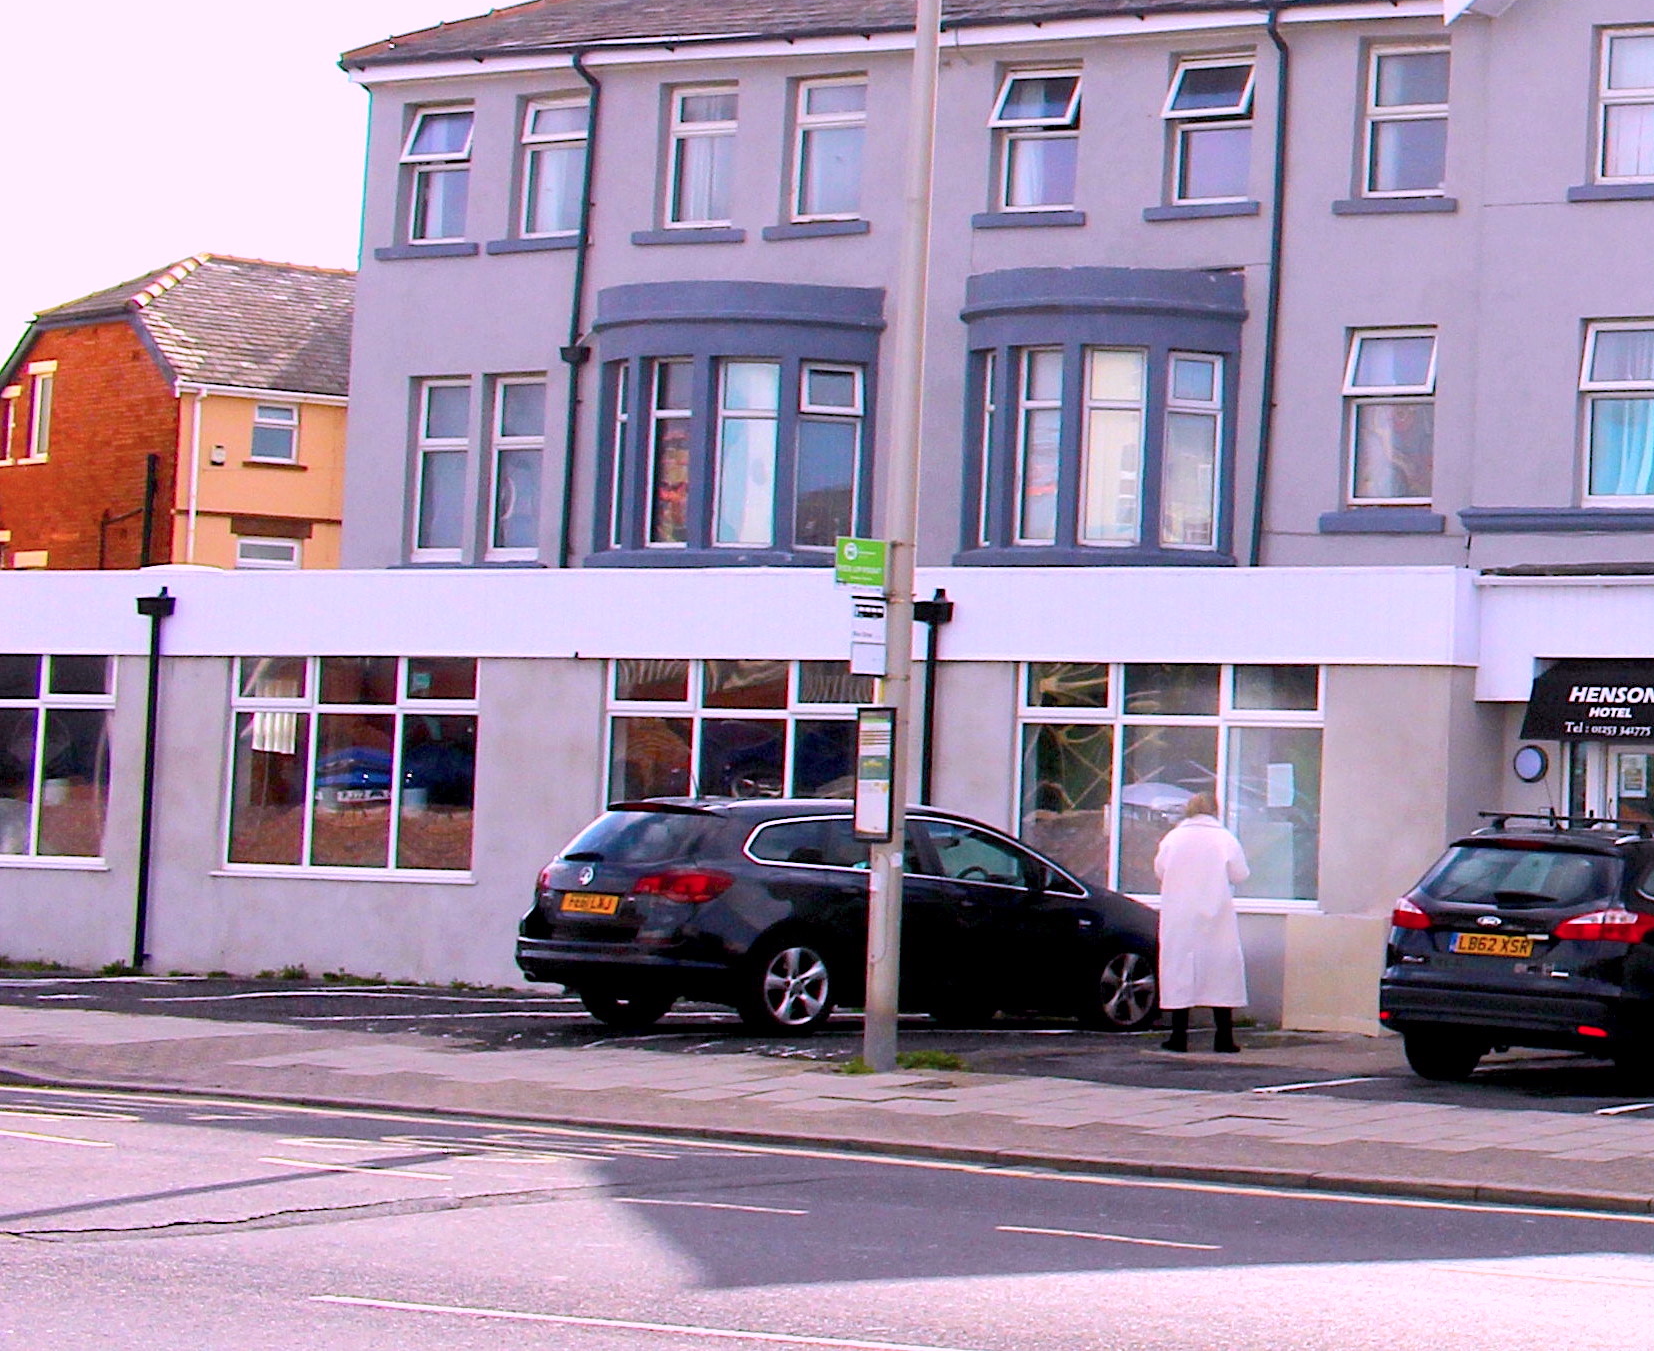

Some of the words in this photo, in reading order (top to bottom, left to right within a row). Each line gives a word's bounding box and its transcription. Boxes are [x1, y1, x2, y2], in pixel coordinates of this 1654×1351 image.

[1588, 707, 1632, 718] HOTEL
[1564, 721, 1583, 733] Tel
[1591, 726, 1617, 736] 01253
[1619, 726, 1652, 736] 341775
[1458, 936, 1497, 952] LB62
[1500, 939, 1530, 954] XSR
